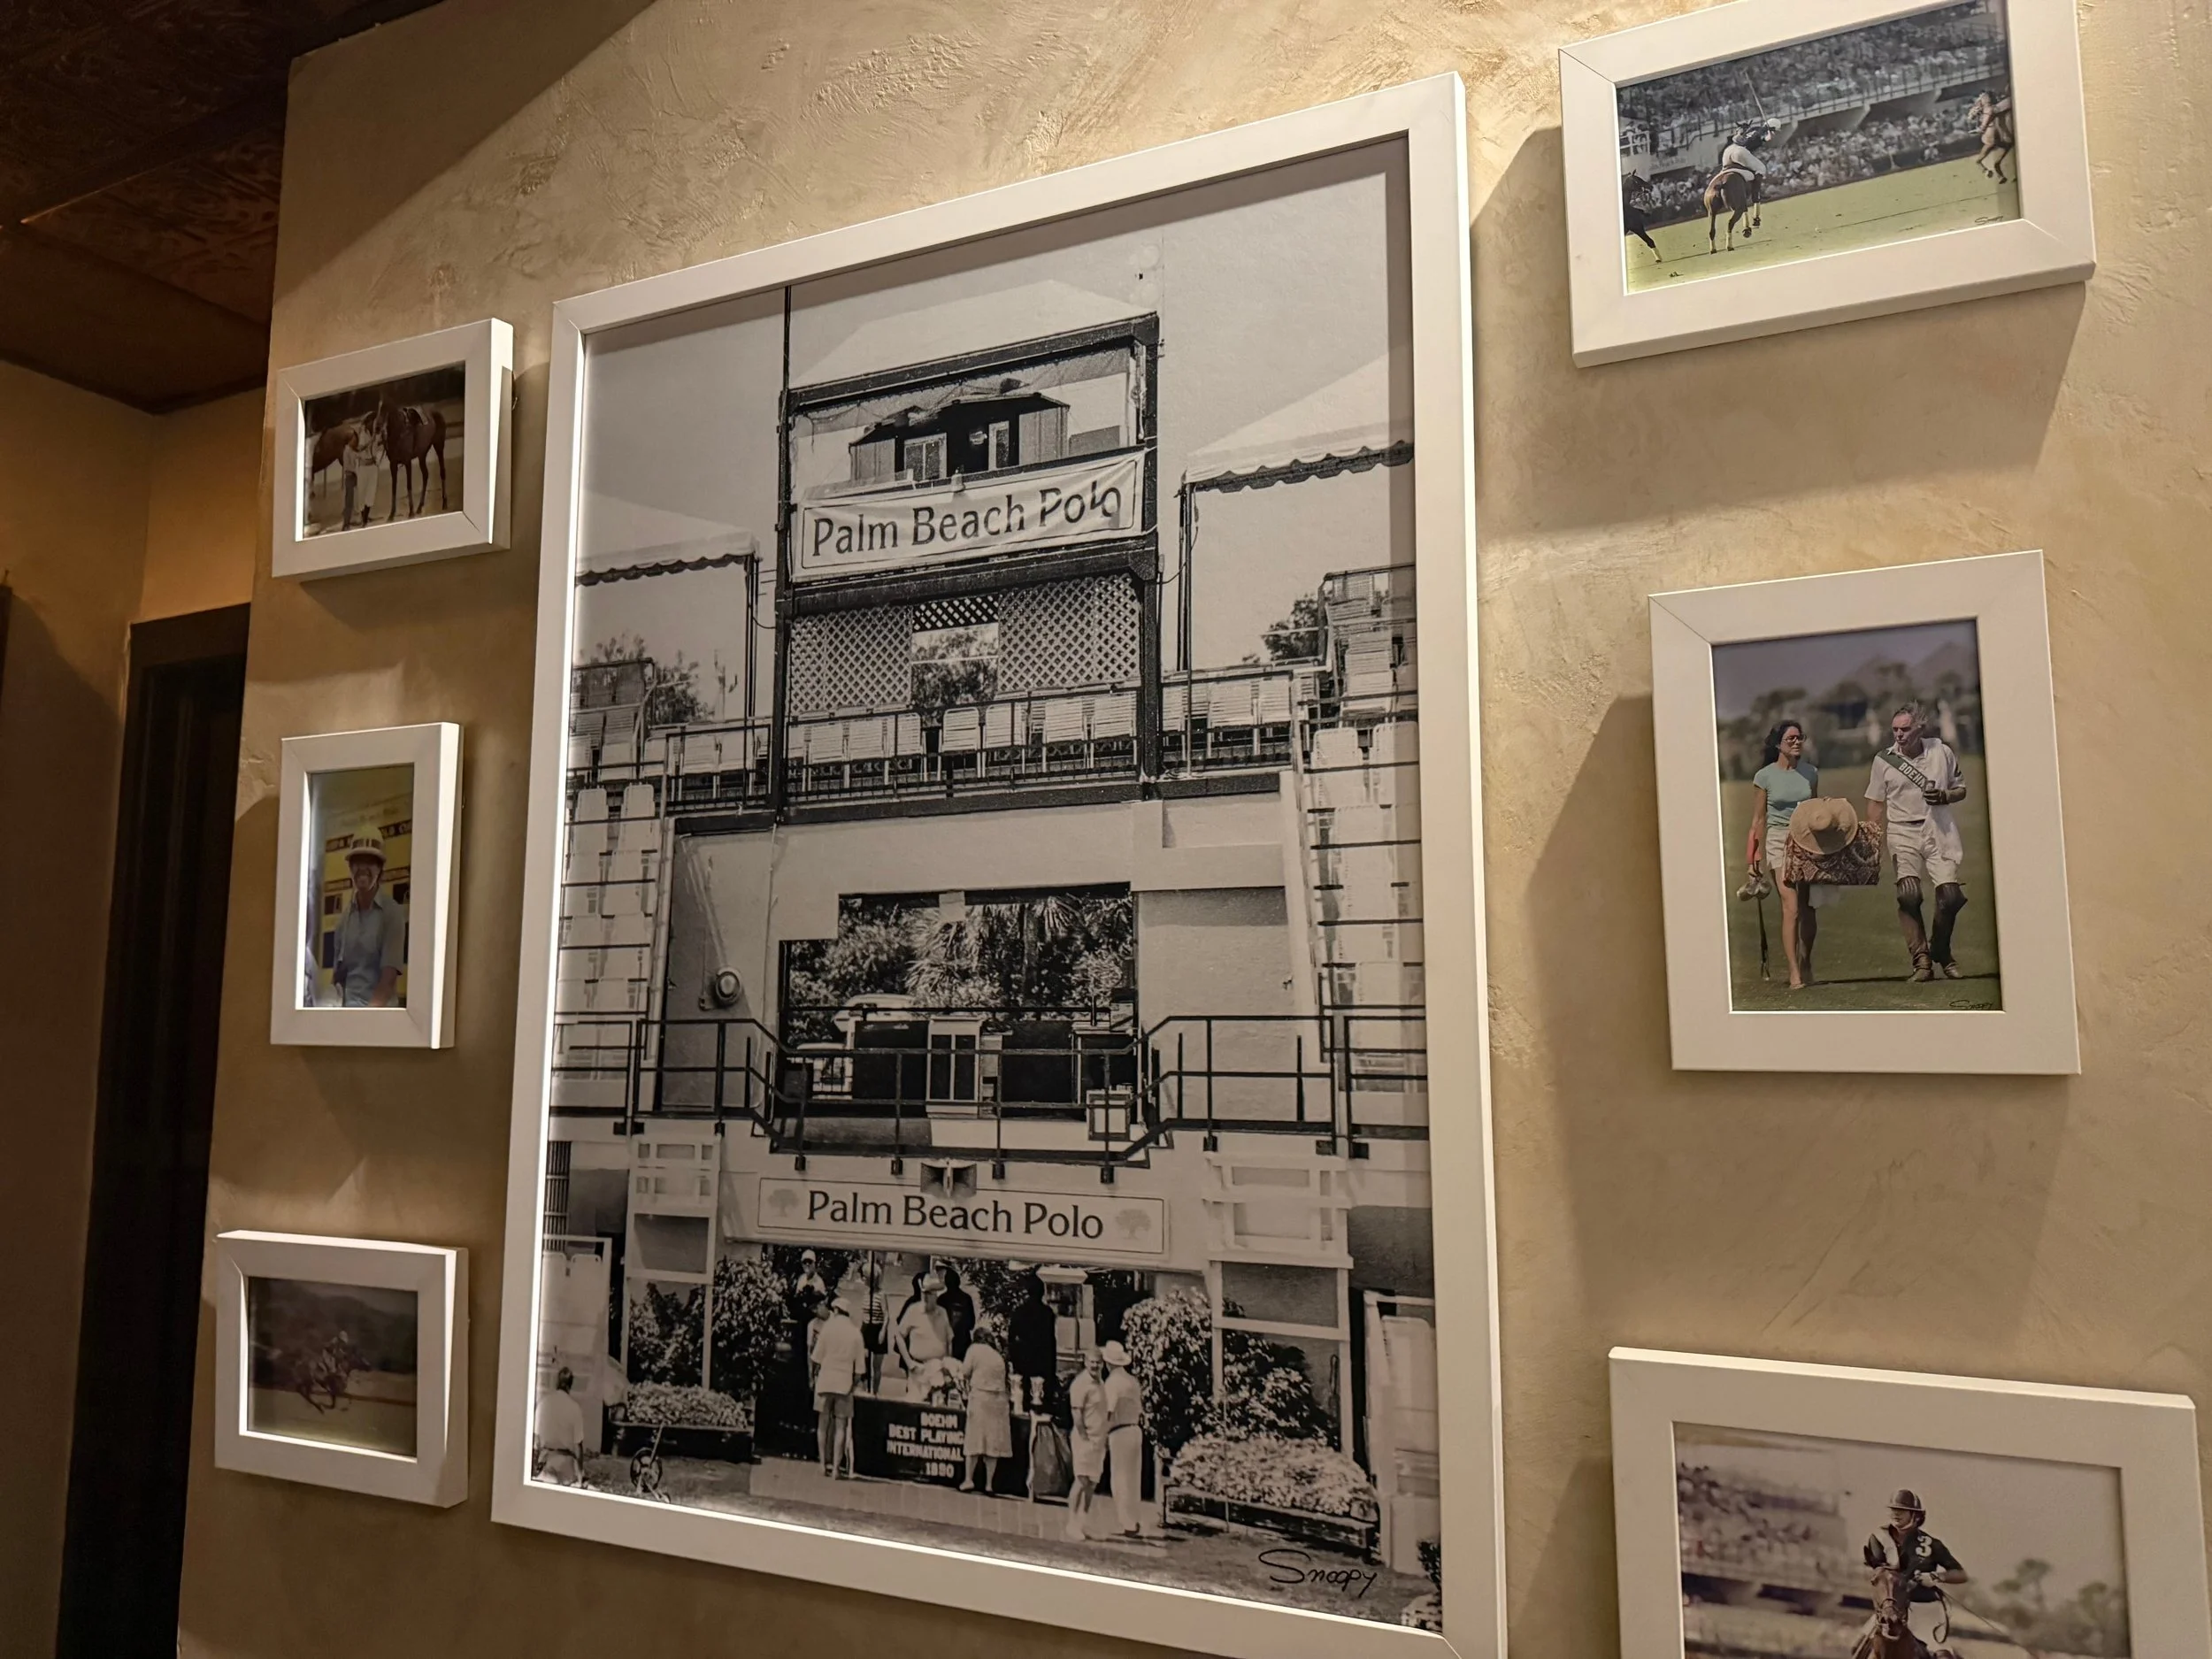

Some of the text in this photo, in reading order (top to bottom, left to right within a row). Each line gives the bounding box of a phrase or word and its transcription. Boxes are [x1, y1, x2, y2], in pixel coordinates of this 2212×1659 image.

[811, 480, 1122, 557] Palm Beach Polo
[806, 1190, 1104, 1240] Palm Beach Polo
[887, 1440, 964, 1462] INTERNATIONAL
[1915, 1535, 1932, 1557] 3
[1258, 1548, 1378, 1599] Snoopy
